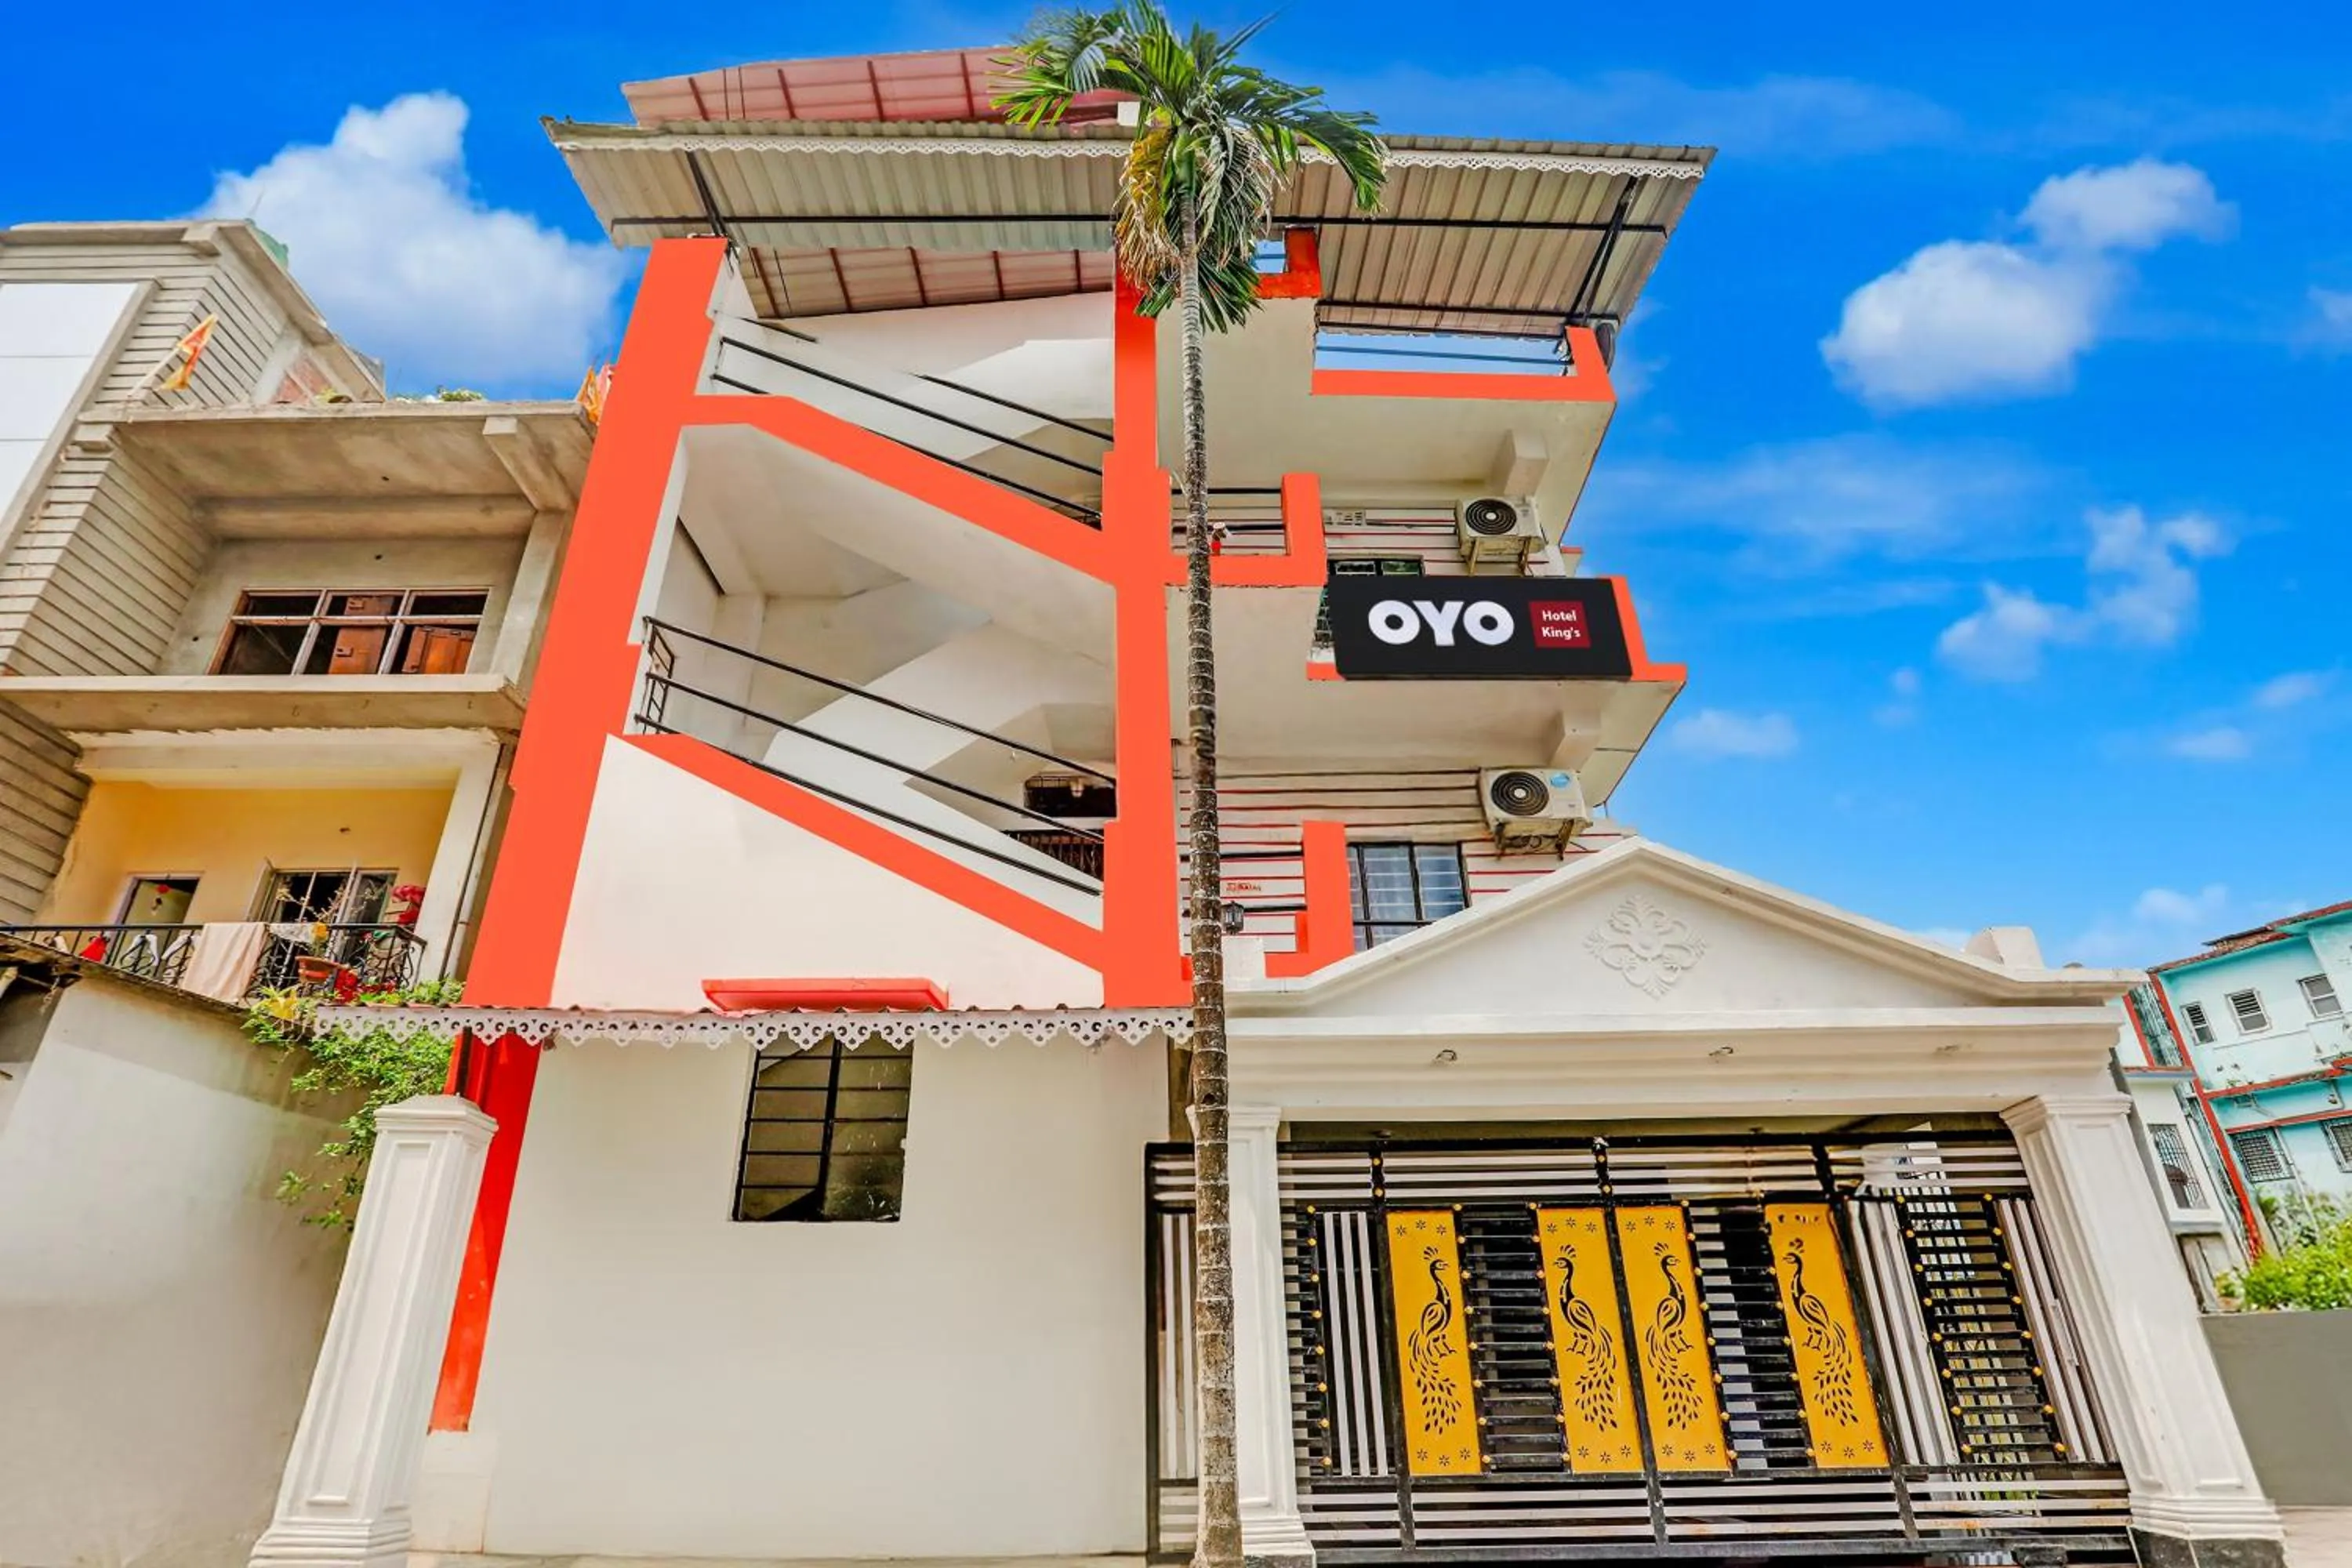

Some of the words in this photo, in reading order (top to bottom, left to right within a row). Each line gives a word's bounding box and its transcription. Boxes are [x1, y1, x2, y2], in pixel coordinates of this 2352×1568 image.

[1542, 610, 1577, 621] Hotel
[1368, 600, 1515, 646] OYO
[1541, 626, 1581, 640] King's
